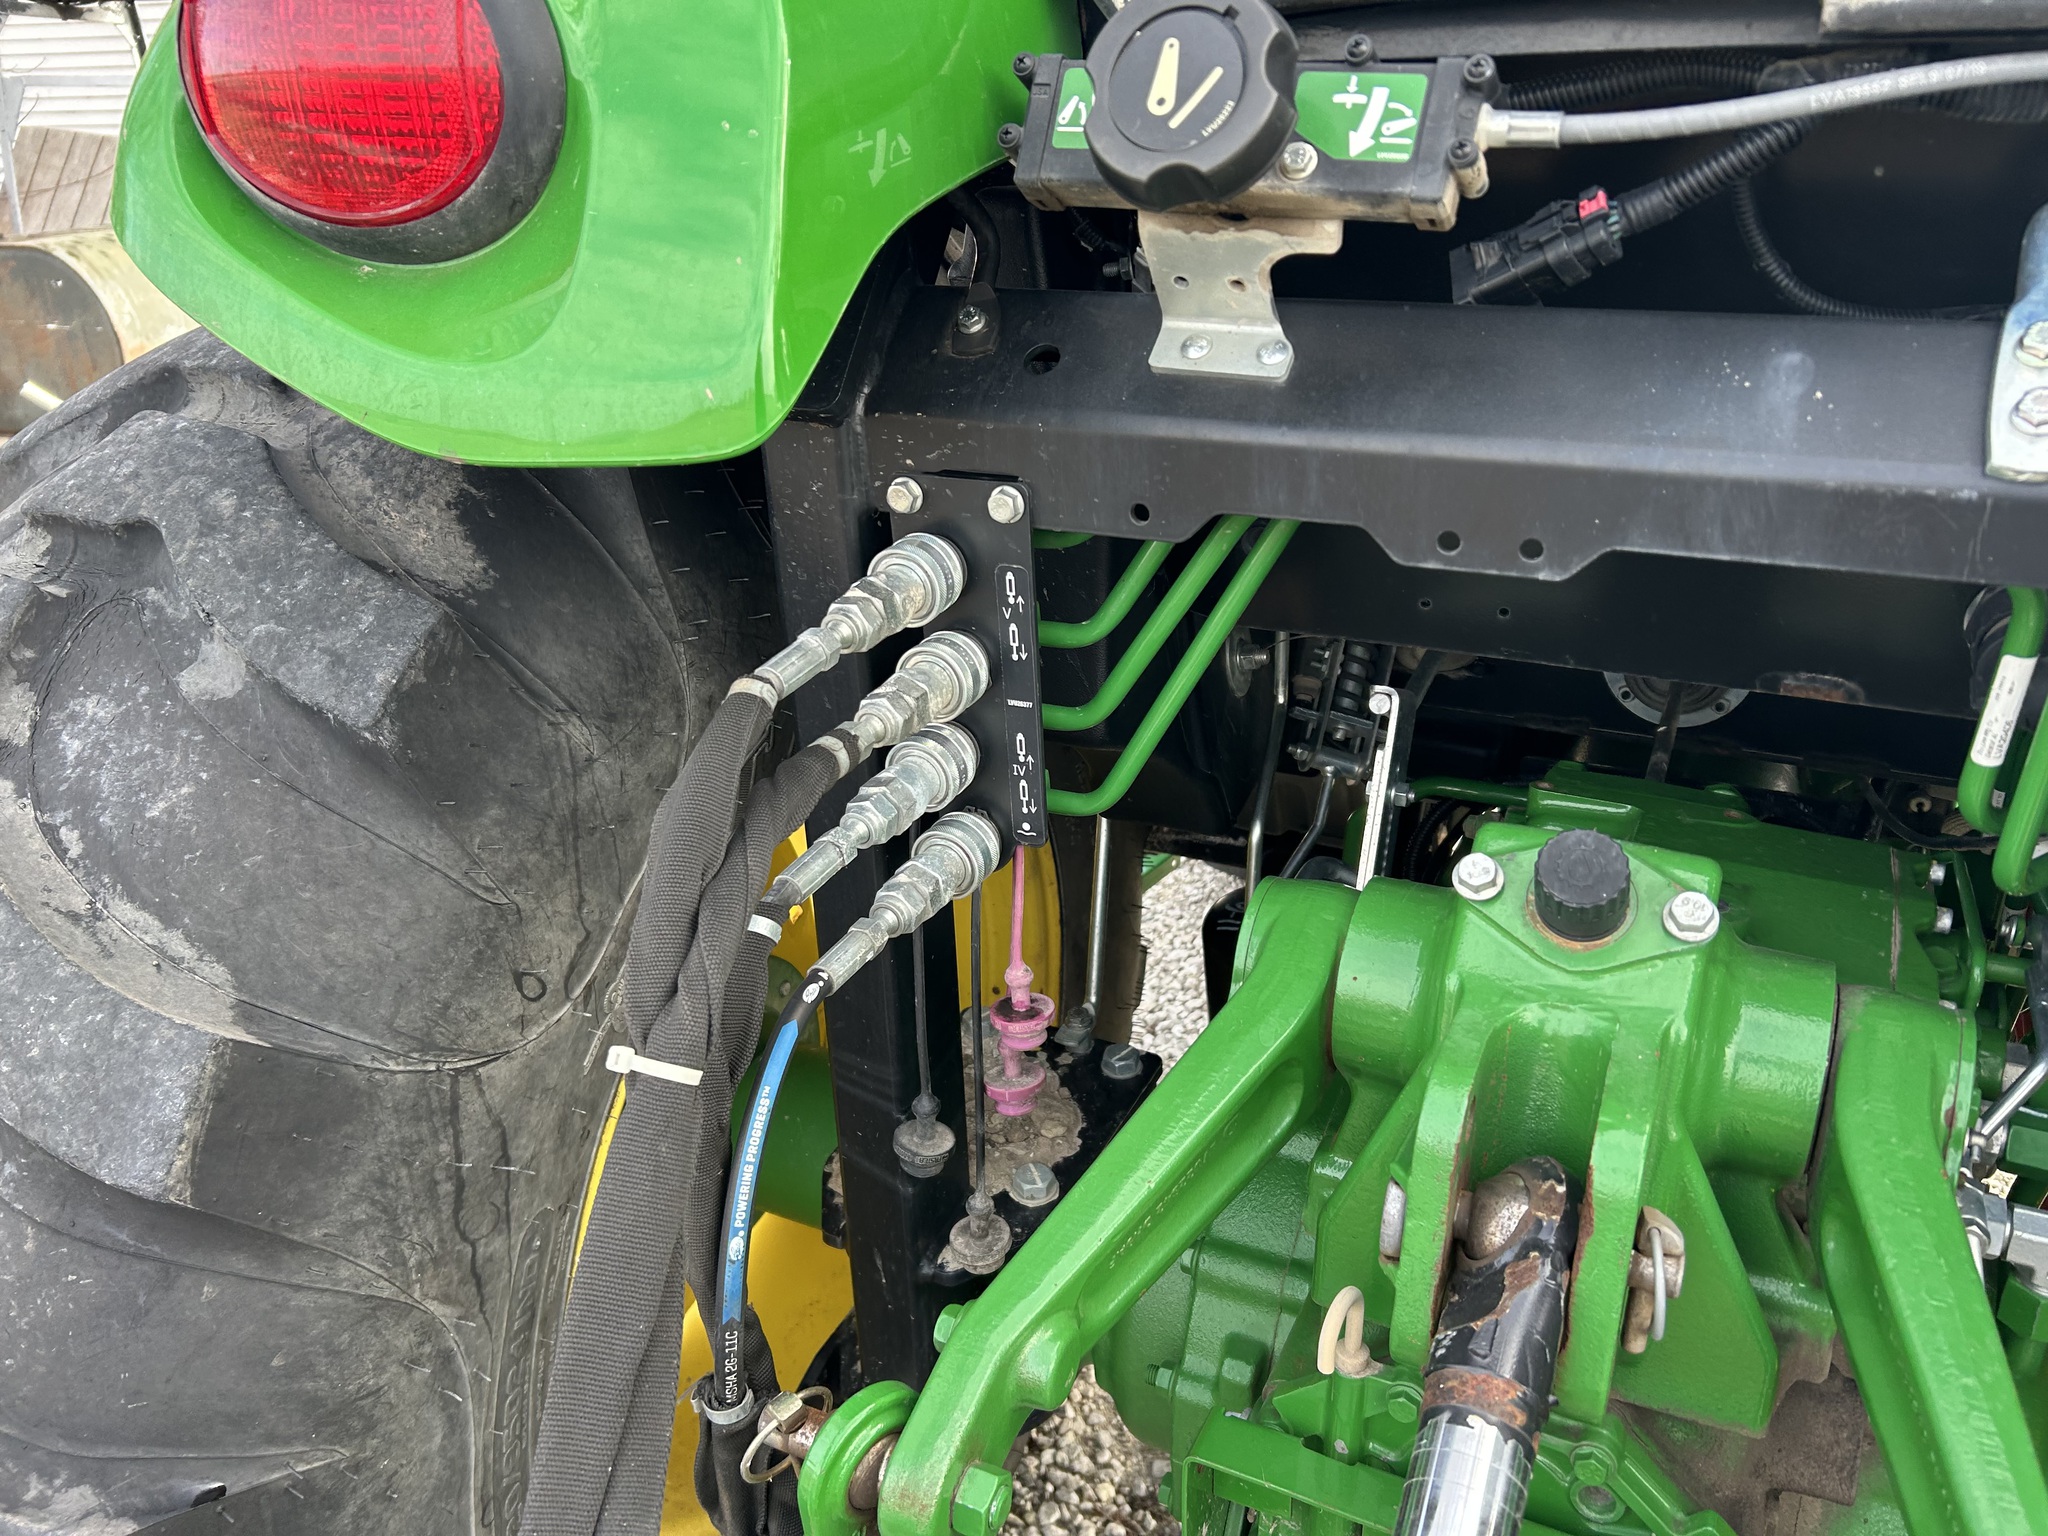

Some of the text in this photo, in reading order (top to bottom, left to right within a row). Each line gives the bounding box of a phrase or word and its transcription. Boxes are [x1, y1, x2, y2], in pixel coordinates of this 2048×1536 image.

[1002, 606, 1012, 619] V
[1012, 763, 1026, 776] IV
[734, 1164, 754, 1227] POWERING
[724, 1330, 738, 1373] 2G-11C
